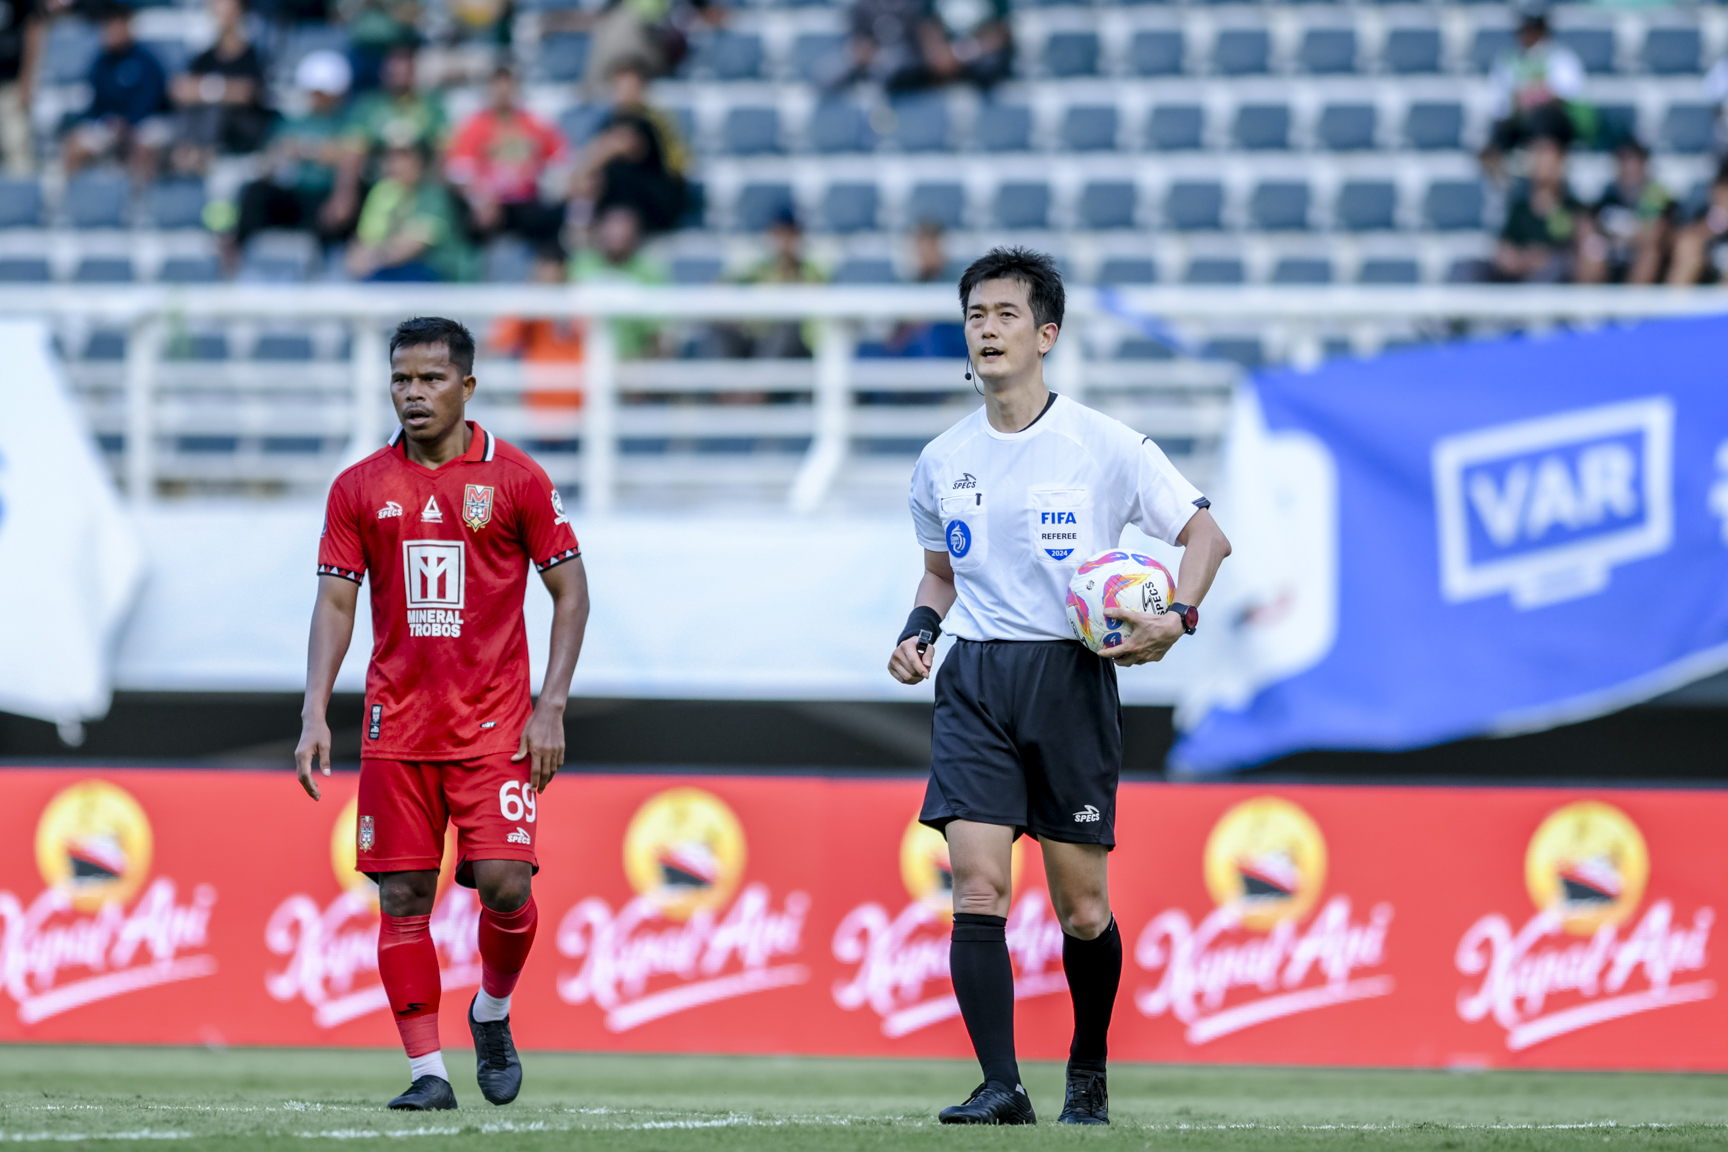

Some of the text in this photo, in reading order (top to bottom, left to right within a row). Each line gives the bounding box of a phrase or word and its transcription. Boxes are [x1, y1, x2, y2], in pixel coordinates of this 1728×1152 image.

[952, 481, 977, 490] SPECS
[1467, 440, 1638, 548] VAR
[378, 508, 403, 519] SPECS
[1041, 512, 1077, 524] FIFA
[1041, 532, 1078, 541] REFEREE
[1051, 549, 1069, 557] 2024
[407, 609, 464, 625] MINERAL
[409, 623, 462, 638] TROBOS
[499, 780, 536, 823] 69
[1073, 811, 1100, 823] SPECS
[507, 834, 531, 845] SPECS
